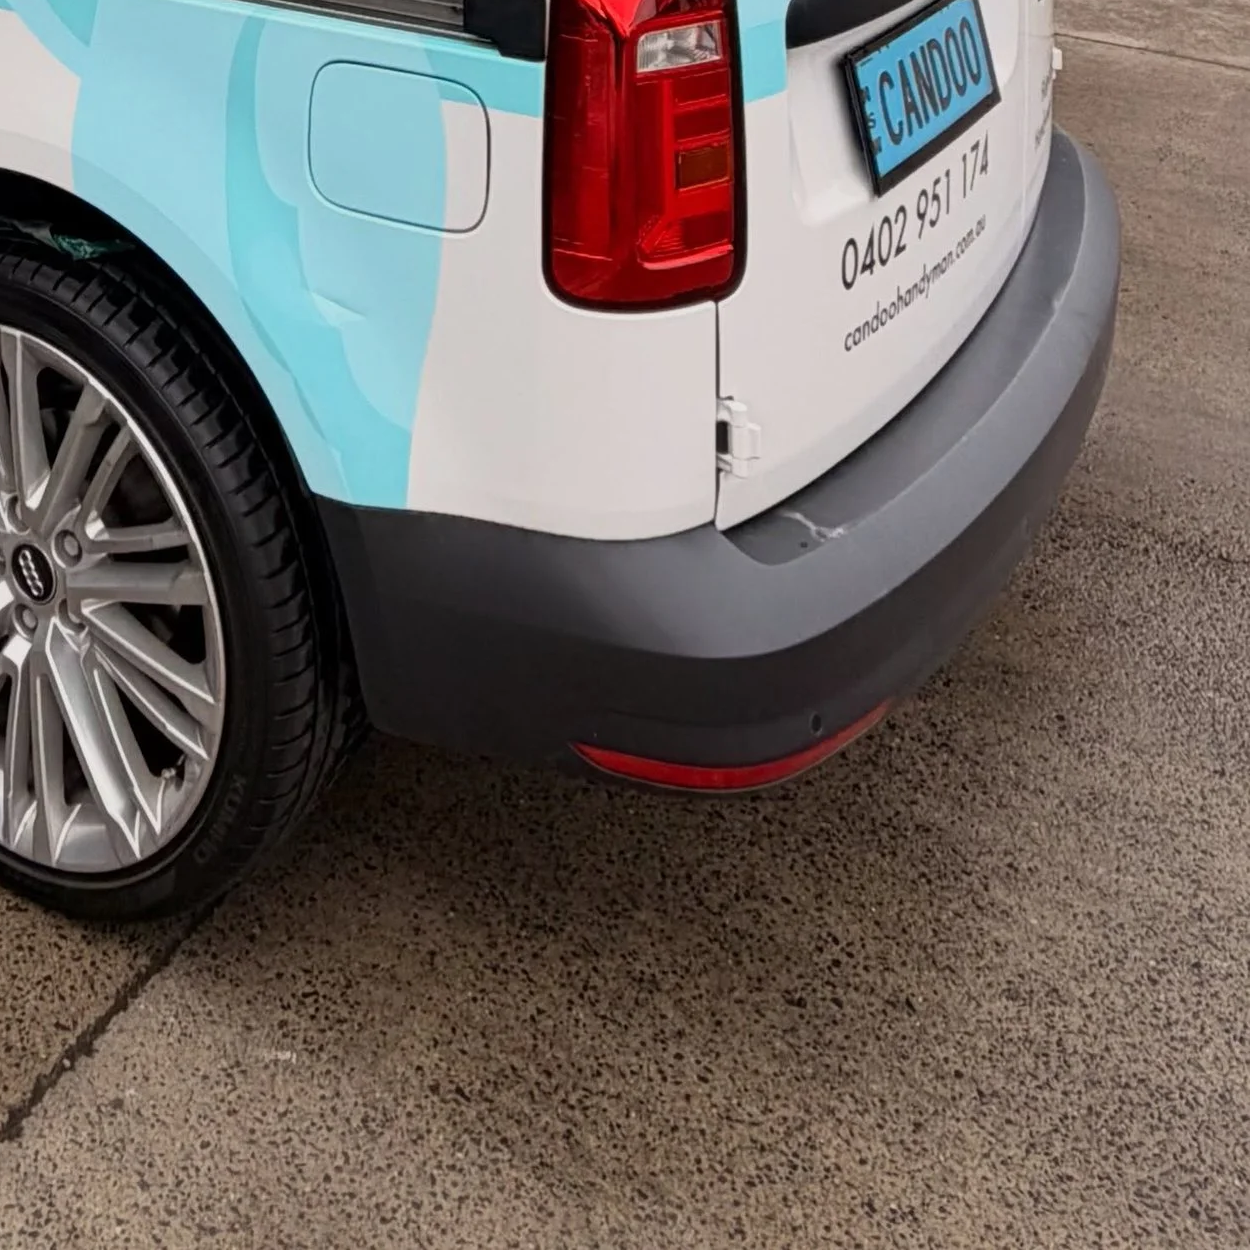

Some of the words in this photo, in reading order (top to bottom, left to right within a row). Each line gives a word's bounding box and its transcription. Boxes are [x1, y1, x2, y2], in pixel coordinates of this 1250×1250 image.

[878, 16, 982, 146] CANDOO
[841, 204, 908, 291] 0402
[916, 169, 951, 239] 951
[962, 130, 989, 198] 174
[844, 214, 987, 352] candoohandyman.com.au
